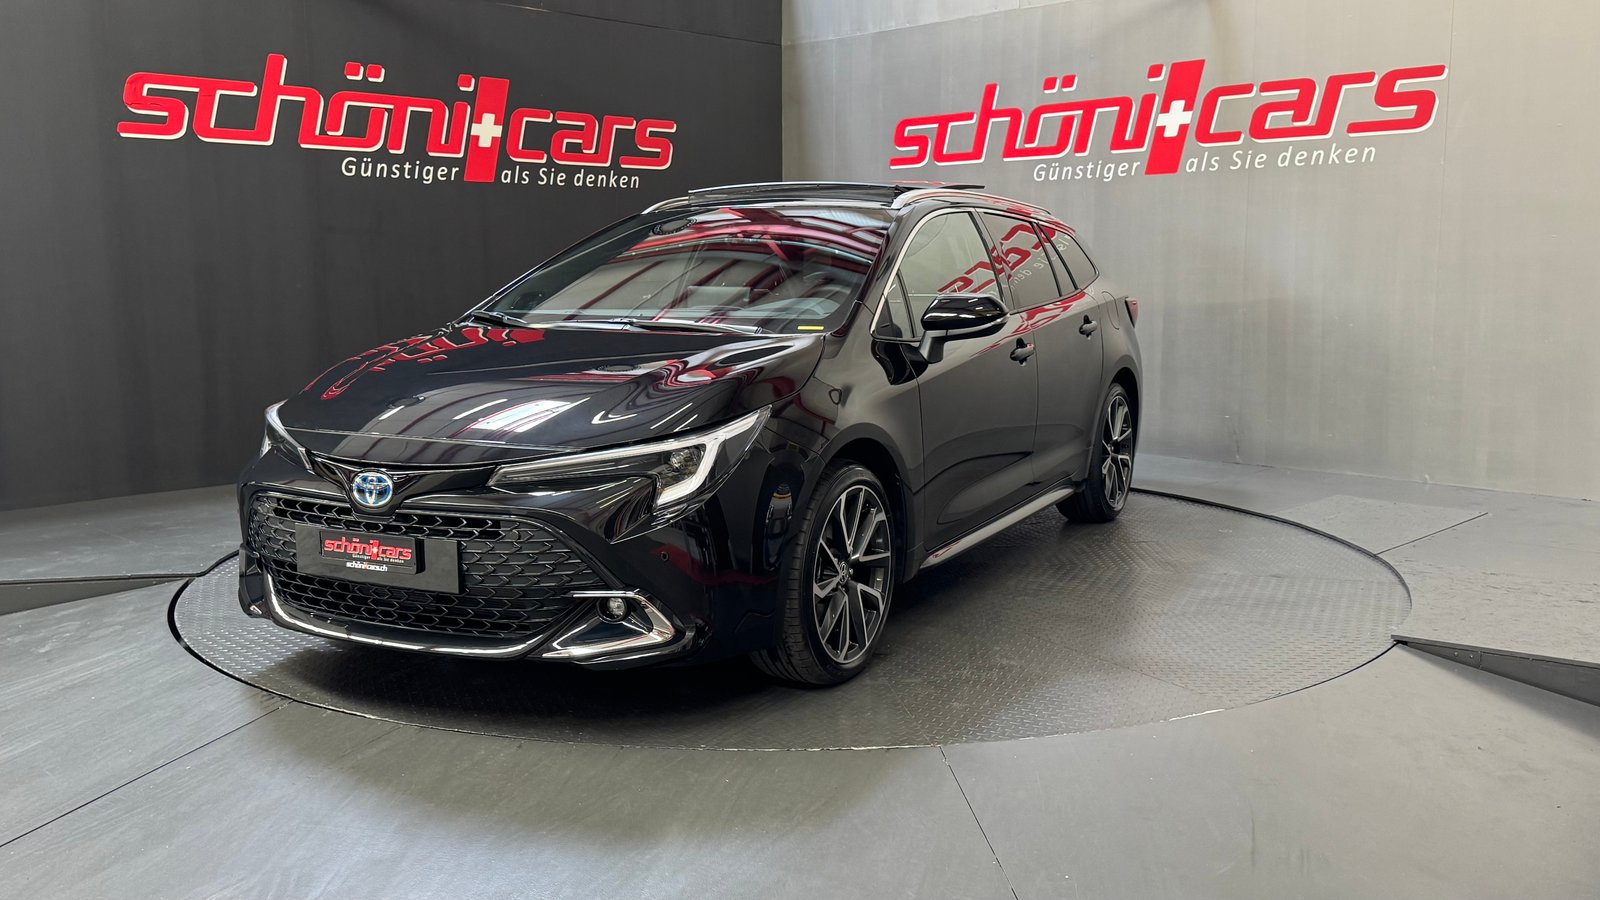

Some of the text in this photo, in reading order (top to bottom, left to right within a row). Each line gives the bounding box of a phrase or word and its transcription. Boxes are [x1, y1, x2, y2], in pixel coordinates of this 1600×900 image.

[341, 156, 640, 189] Günstiger als Sie denken
[1033, 143, 1377, 182] Günstiger als Sie denken
